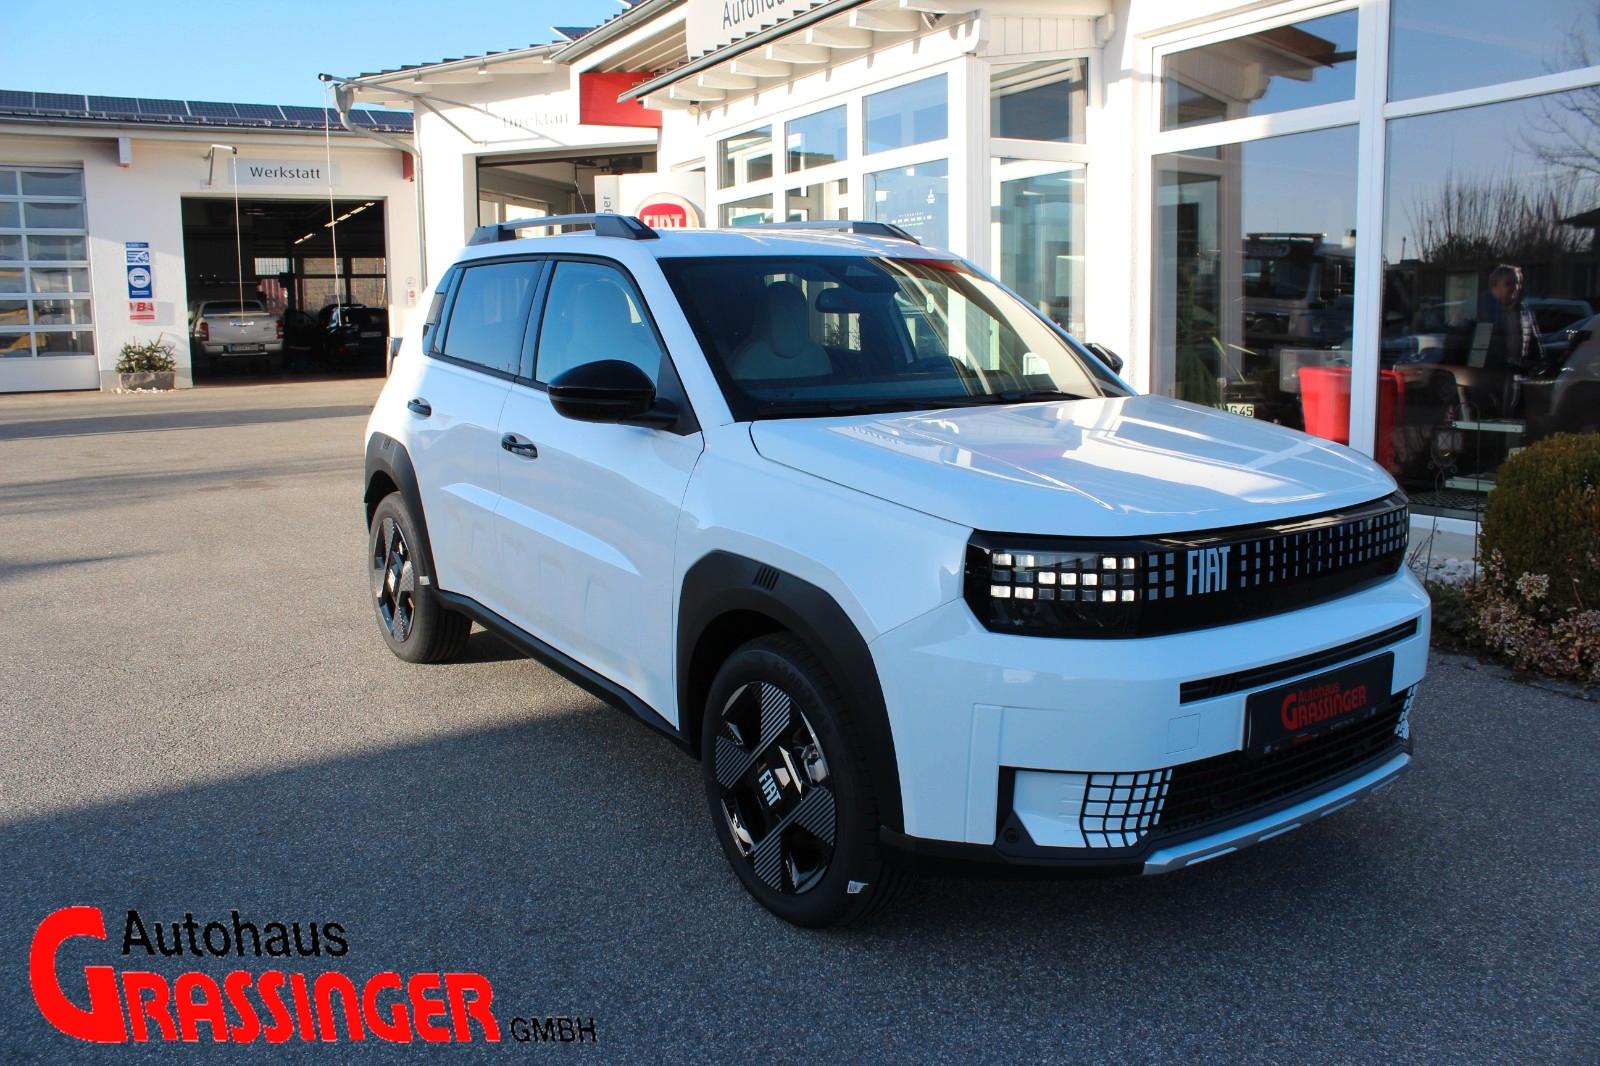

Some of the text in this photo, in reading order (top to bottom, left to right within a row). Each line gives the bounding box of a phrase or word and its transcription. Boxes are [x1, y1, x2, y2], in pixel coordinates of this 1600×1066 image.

[249, 165, 321, 179] Werkstatt
[1187, 546, 1231, 595] FIAT
[1298, 681, 1342, 704] Autohaus
[758, 769, 781, 806] FIAT
